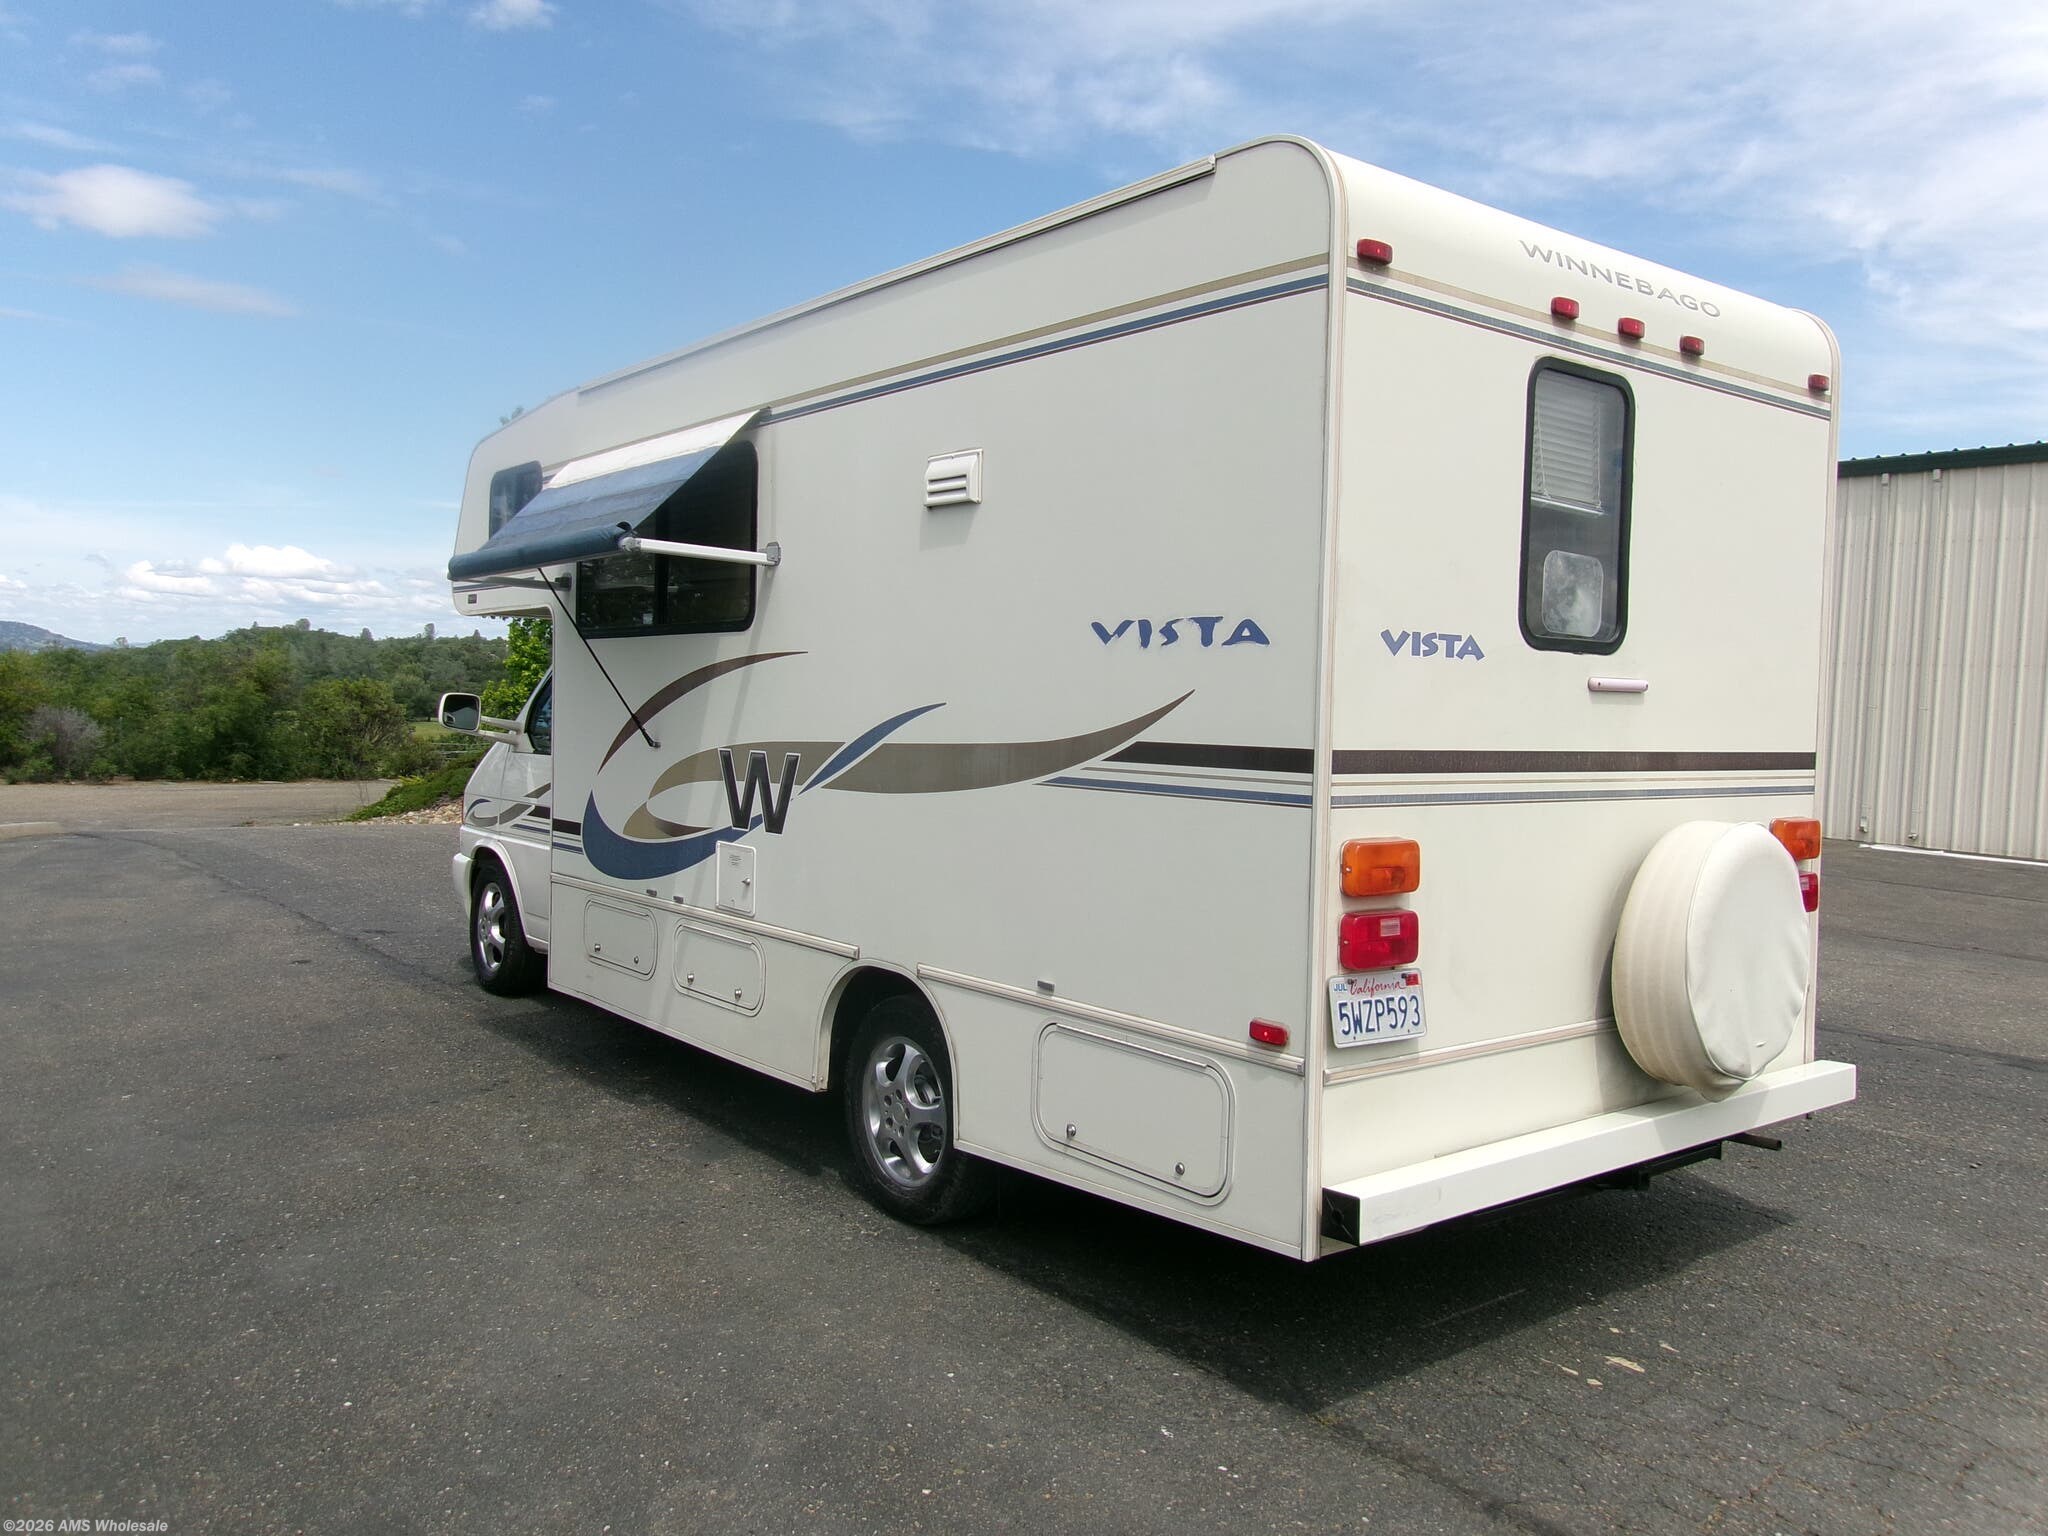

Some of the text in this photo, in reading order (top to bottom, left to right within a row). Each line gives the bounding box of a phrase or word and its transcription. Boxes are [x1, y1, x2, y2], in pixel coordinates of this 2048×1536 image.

[1519, 240, 1721, 317] WINNEBAGO
[1090, 616, 1270, 648] VISTA
[1380, 629, 1486, 662] VISTA
[718, 749, 800, 834] W
[1334, 983, 1347, 991] JUL
[1349, 977, 1406, 997] California
[1338, 995, 1420, 1035] 5WZP593
